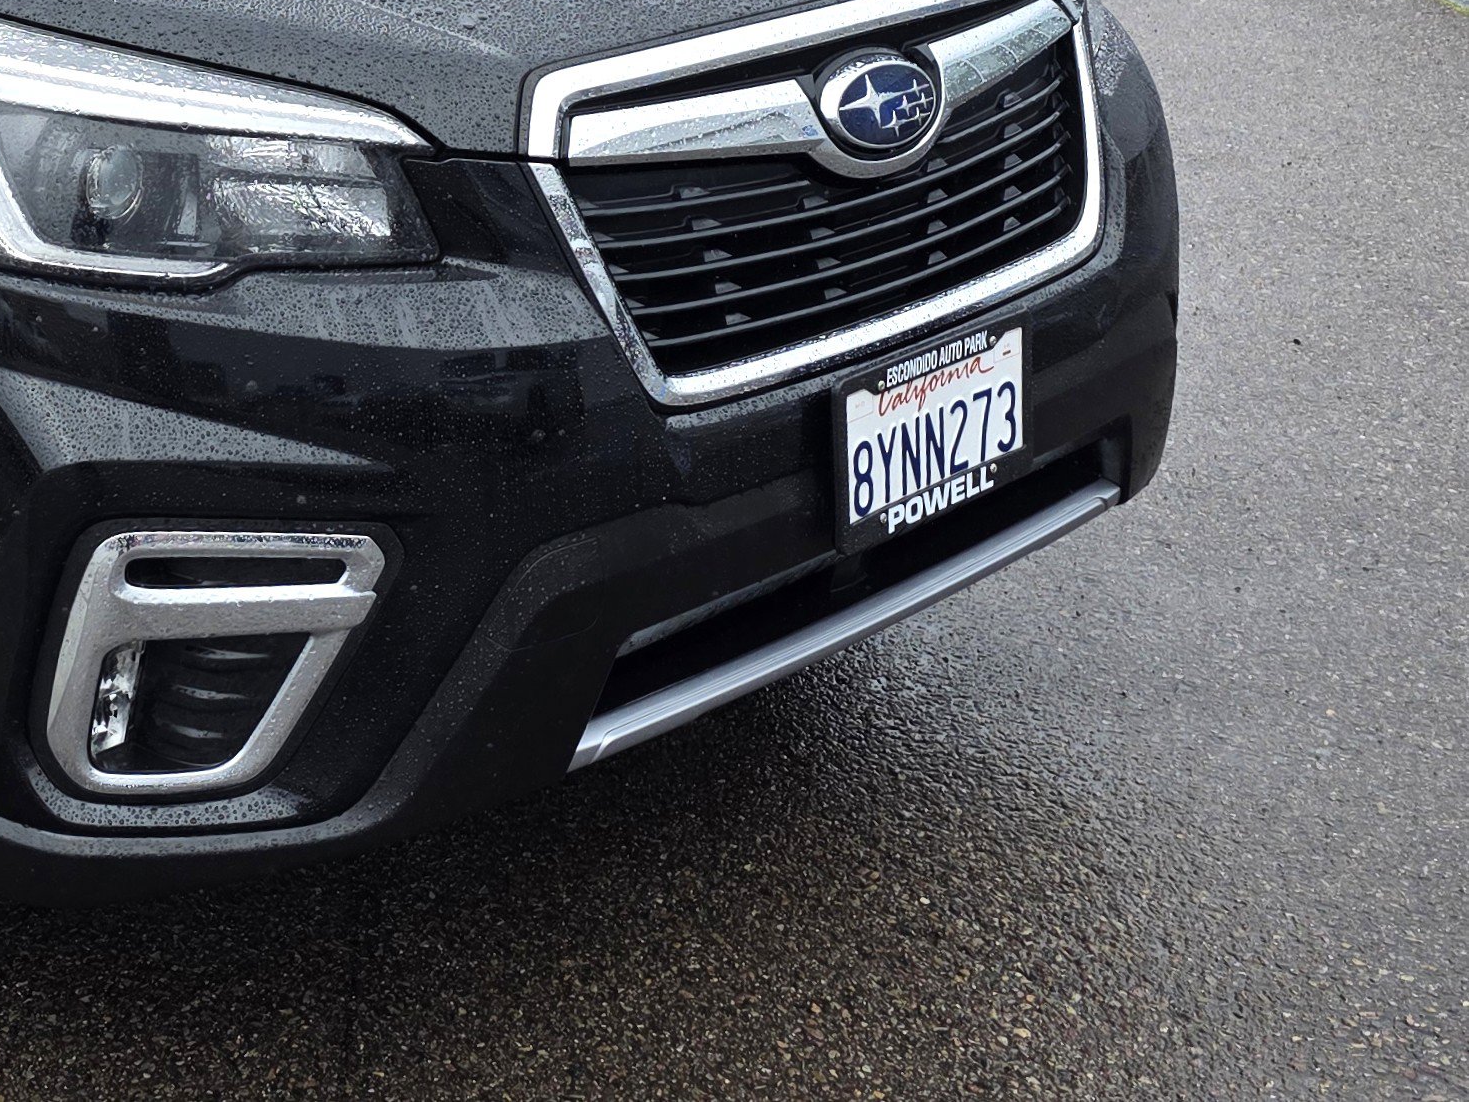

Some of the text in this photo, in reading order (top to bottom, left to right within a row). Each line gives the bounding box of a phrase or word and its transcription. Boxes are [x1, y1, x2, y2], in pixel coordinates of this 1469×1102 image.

[878, 356, 994, 417] California
[886, 330, 988, 388] ESCONDIDO AUTO PARK
[852, 380, 1017, 518] 8YNN273
[887, 466, 994, 534] POWELL
